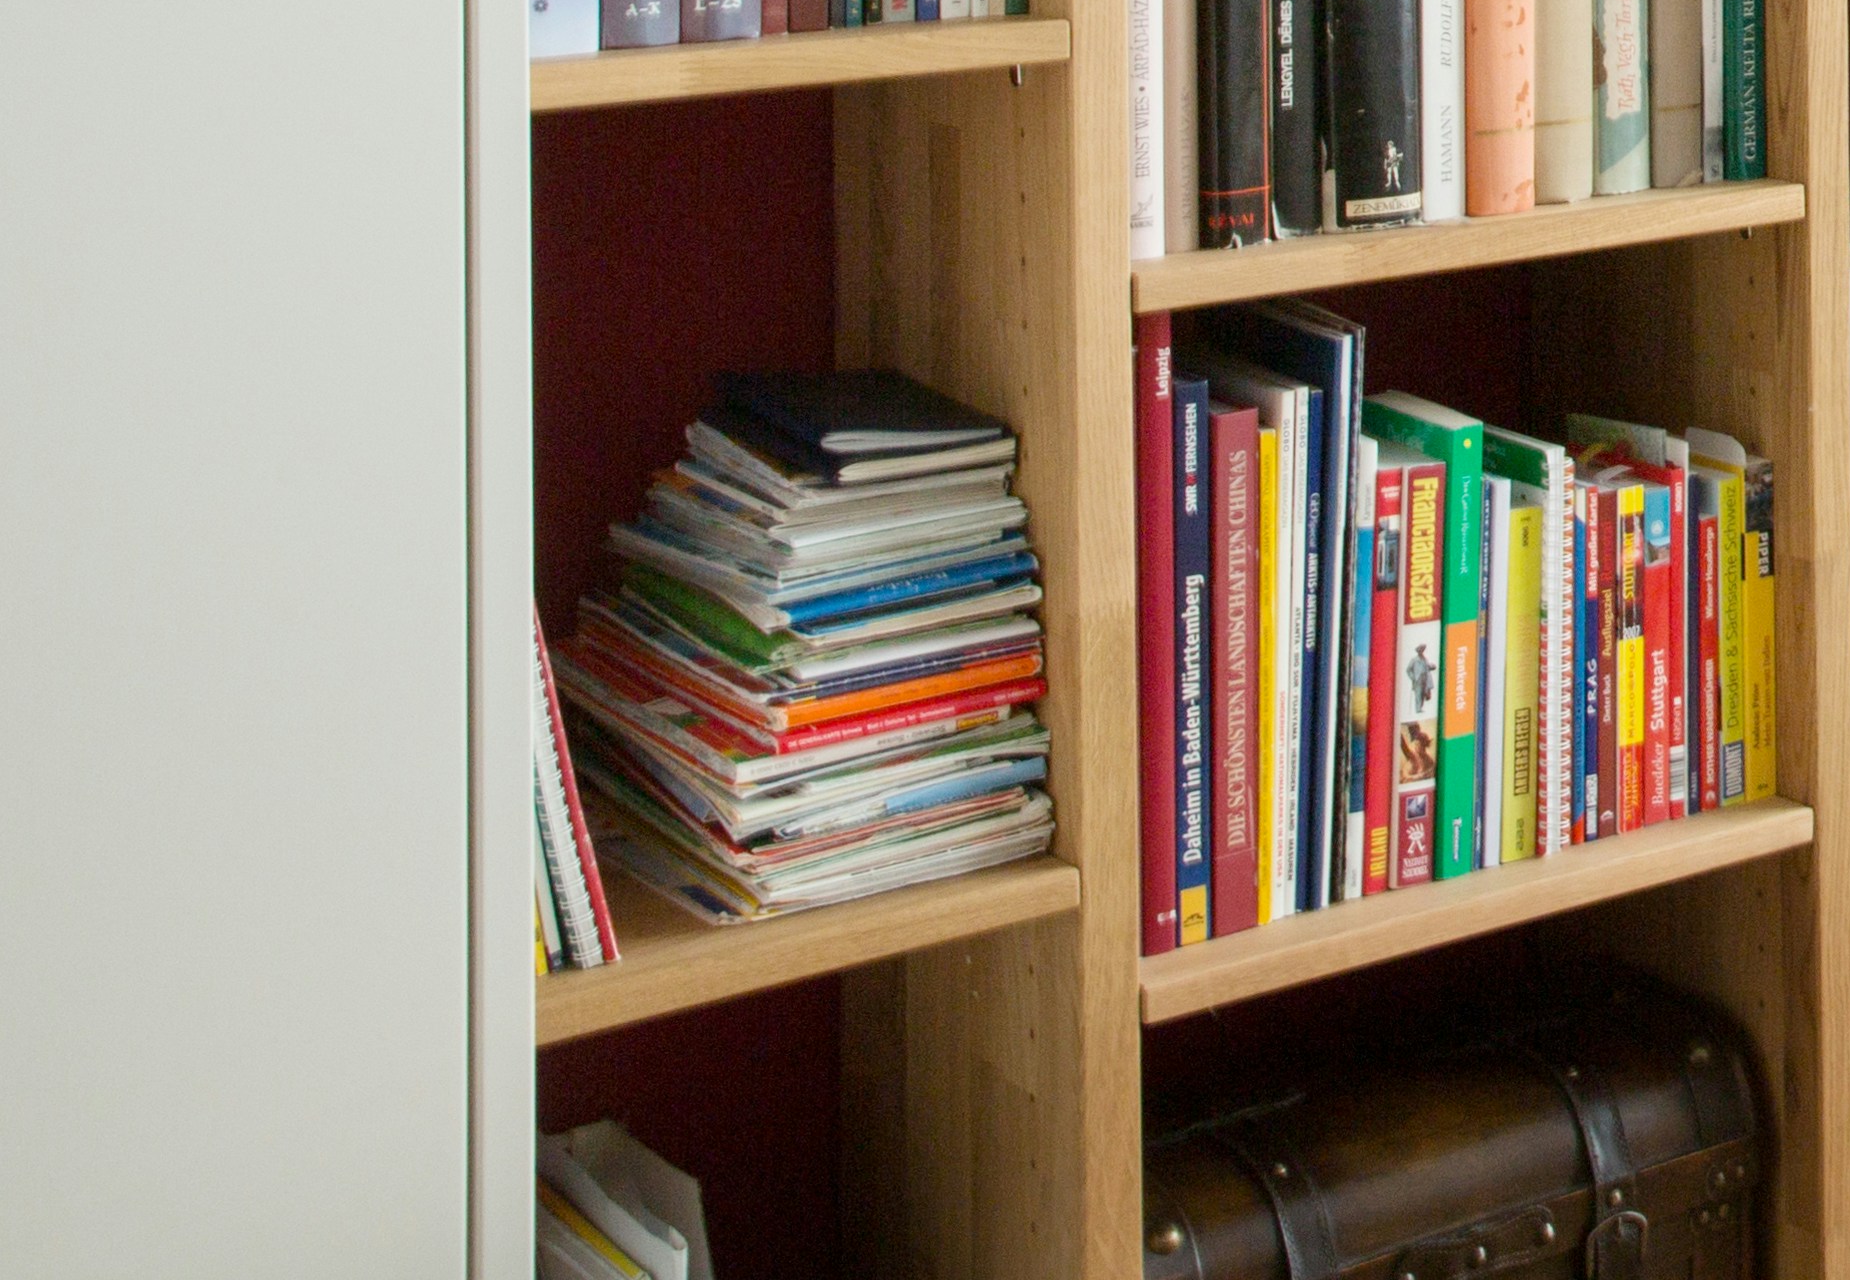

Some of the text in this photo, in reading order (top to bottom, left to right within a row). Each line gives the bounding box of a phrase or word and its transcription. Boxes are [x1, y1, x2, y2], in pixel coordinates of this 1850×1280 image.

[1280, 48, 1294, 112] LENGYEL
[1134, 132, 1151, 181] ERNST
[1440, 104, 1453, 184] HAMANN
[1154, 346, 1171, 398] Leipzig
[1184, 401, 1198, 473] FERNSEHEN
[1759, 530, 1769, 577] PIPER
[1587, 658, 1598, 715] PRAG
[1651, 648, 1665, 733] Stuttgart
[1182, 768, 1201, 785] in
[1181, 787, 1203, 865] Daheim
[1369, 826, 1388, 879] IRLAND
